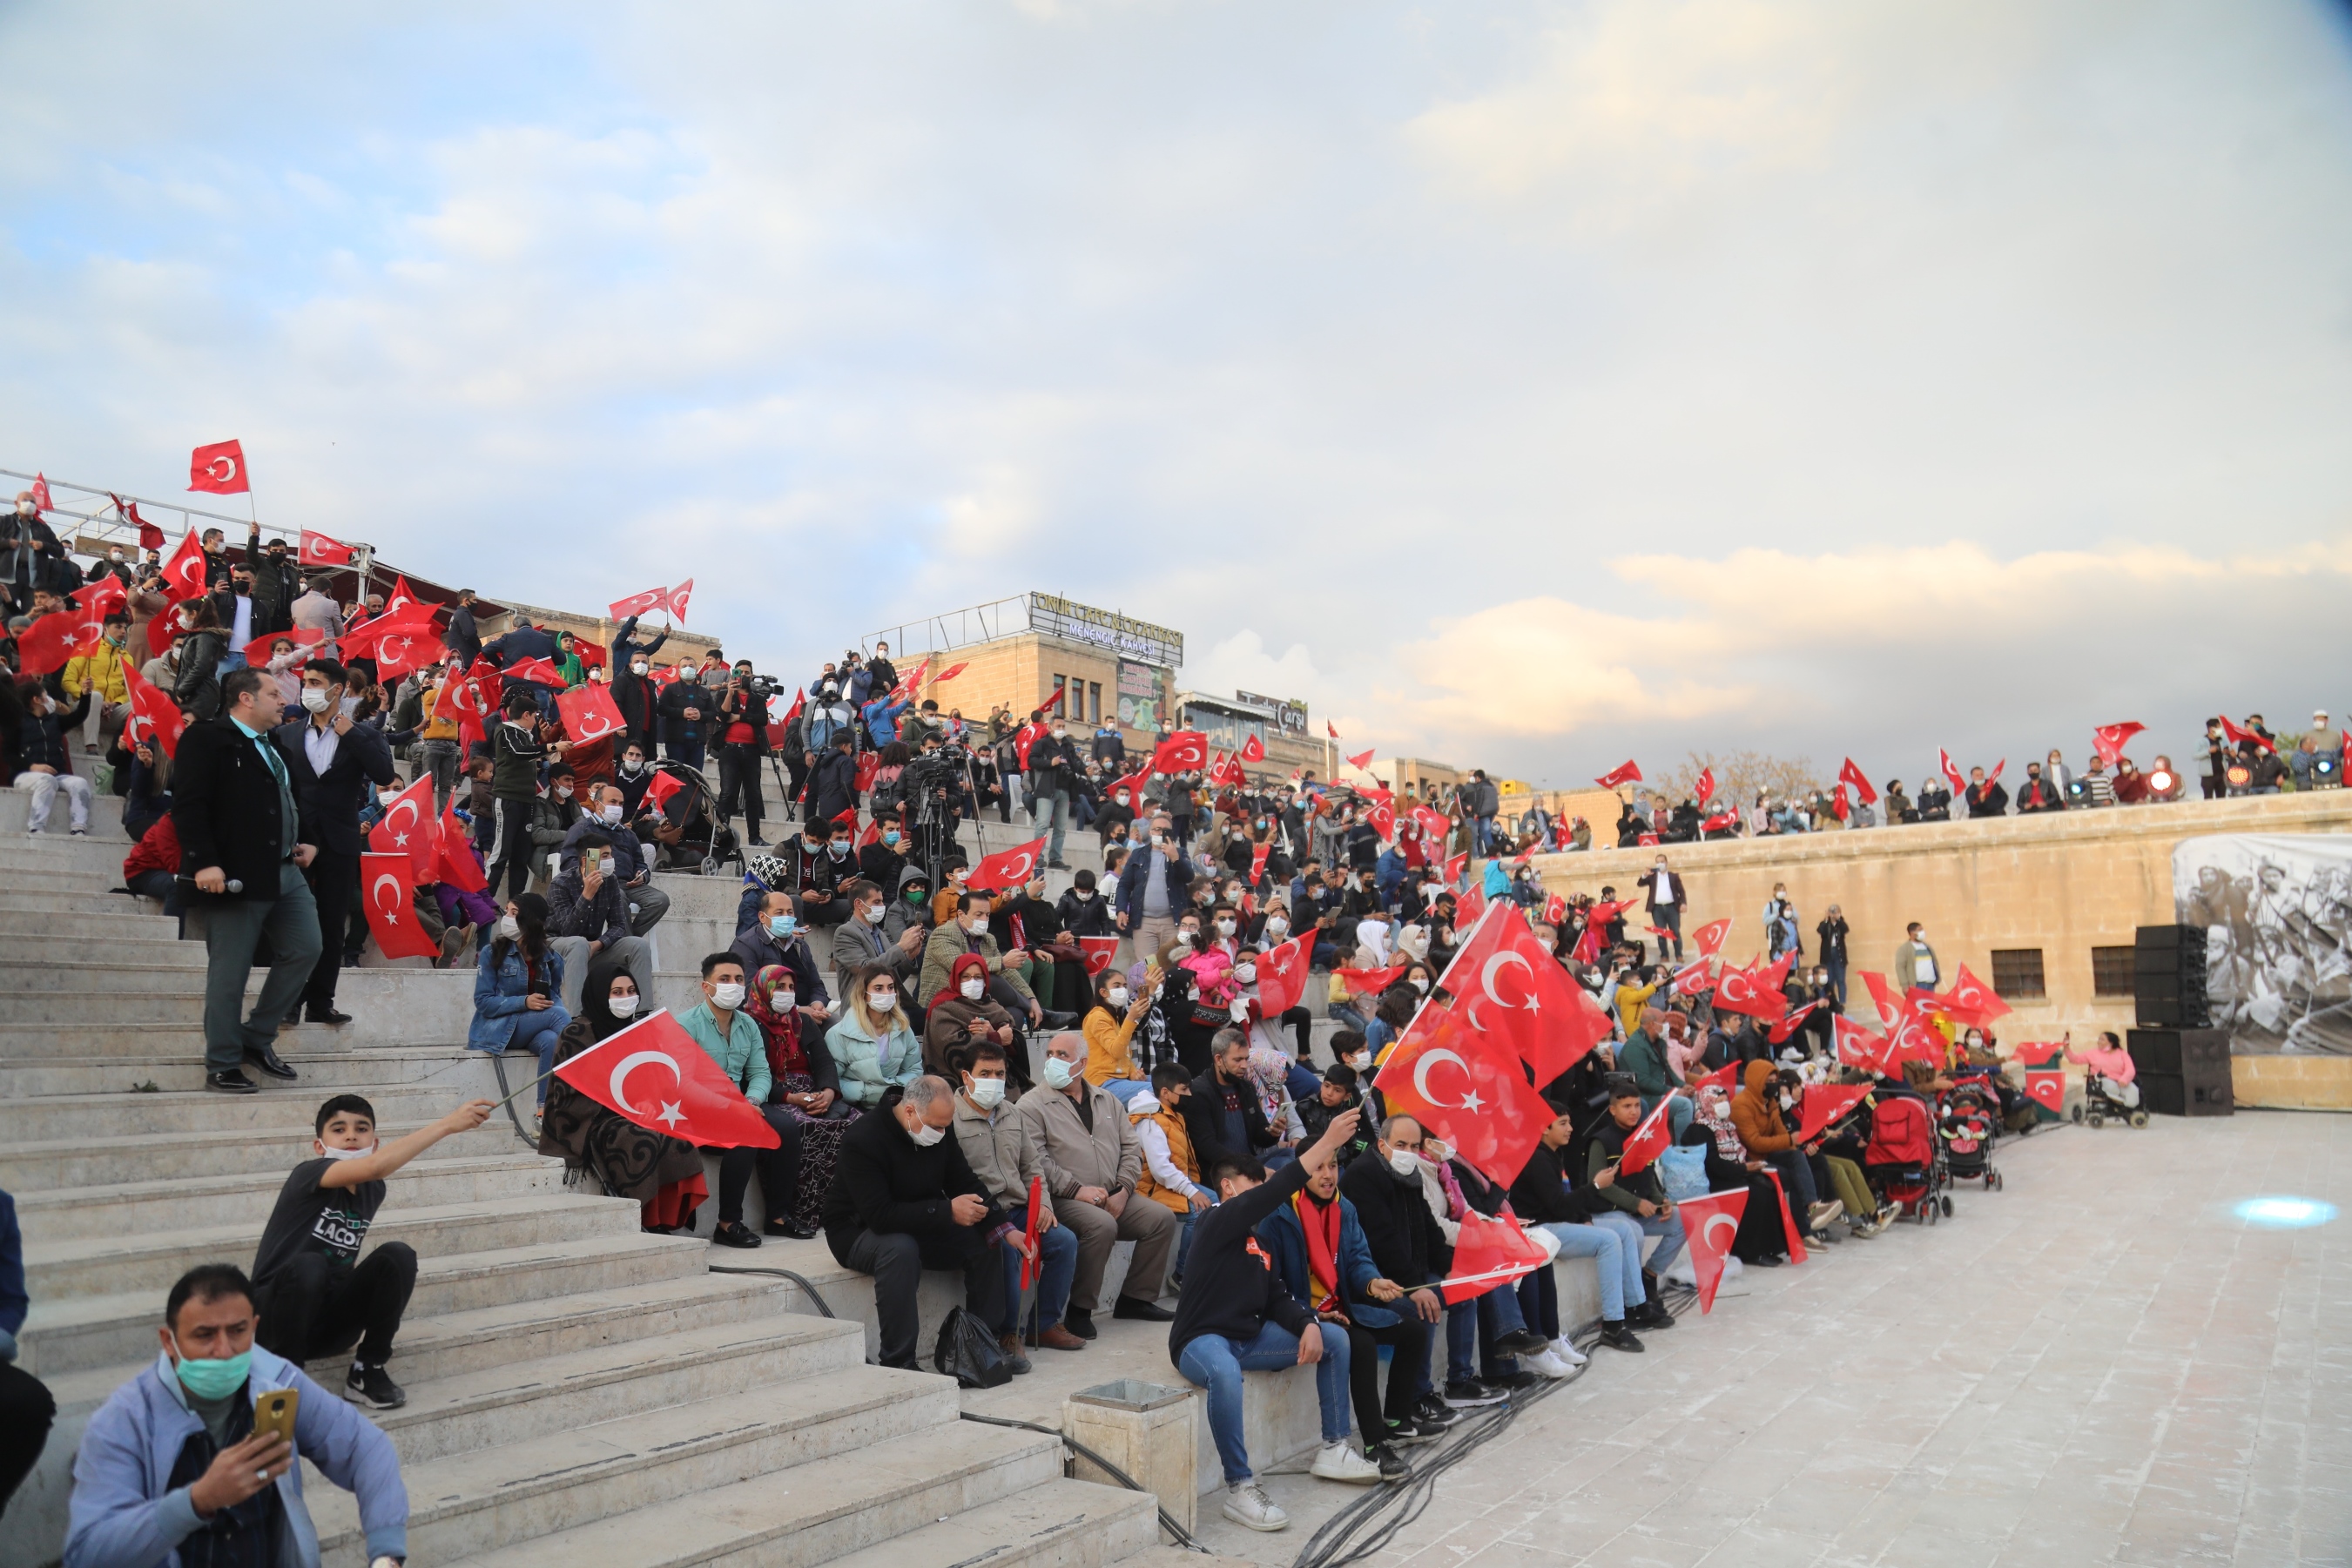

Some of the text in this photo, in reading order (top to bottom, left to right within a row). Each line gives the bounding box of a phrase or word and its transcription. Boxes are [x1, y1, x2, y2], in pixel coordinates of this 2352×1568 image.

[1036, 593, 1071, 616] ONUR
[1075, 603, 1109, 627] CAFE
[1111, 613, 1122, 630] &
[1069, 624, 1155, 656] MENENGİÇ KAHVESİ
[1277, 702, 1304, 737] Çarşı
